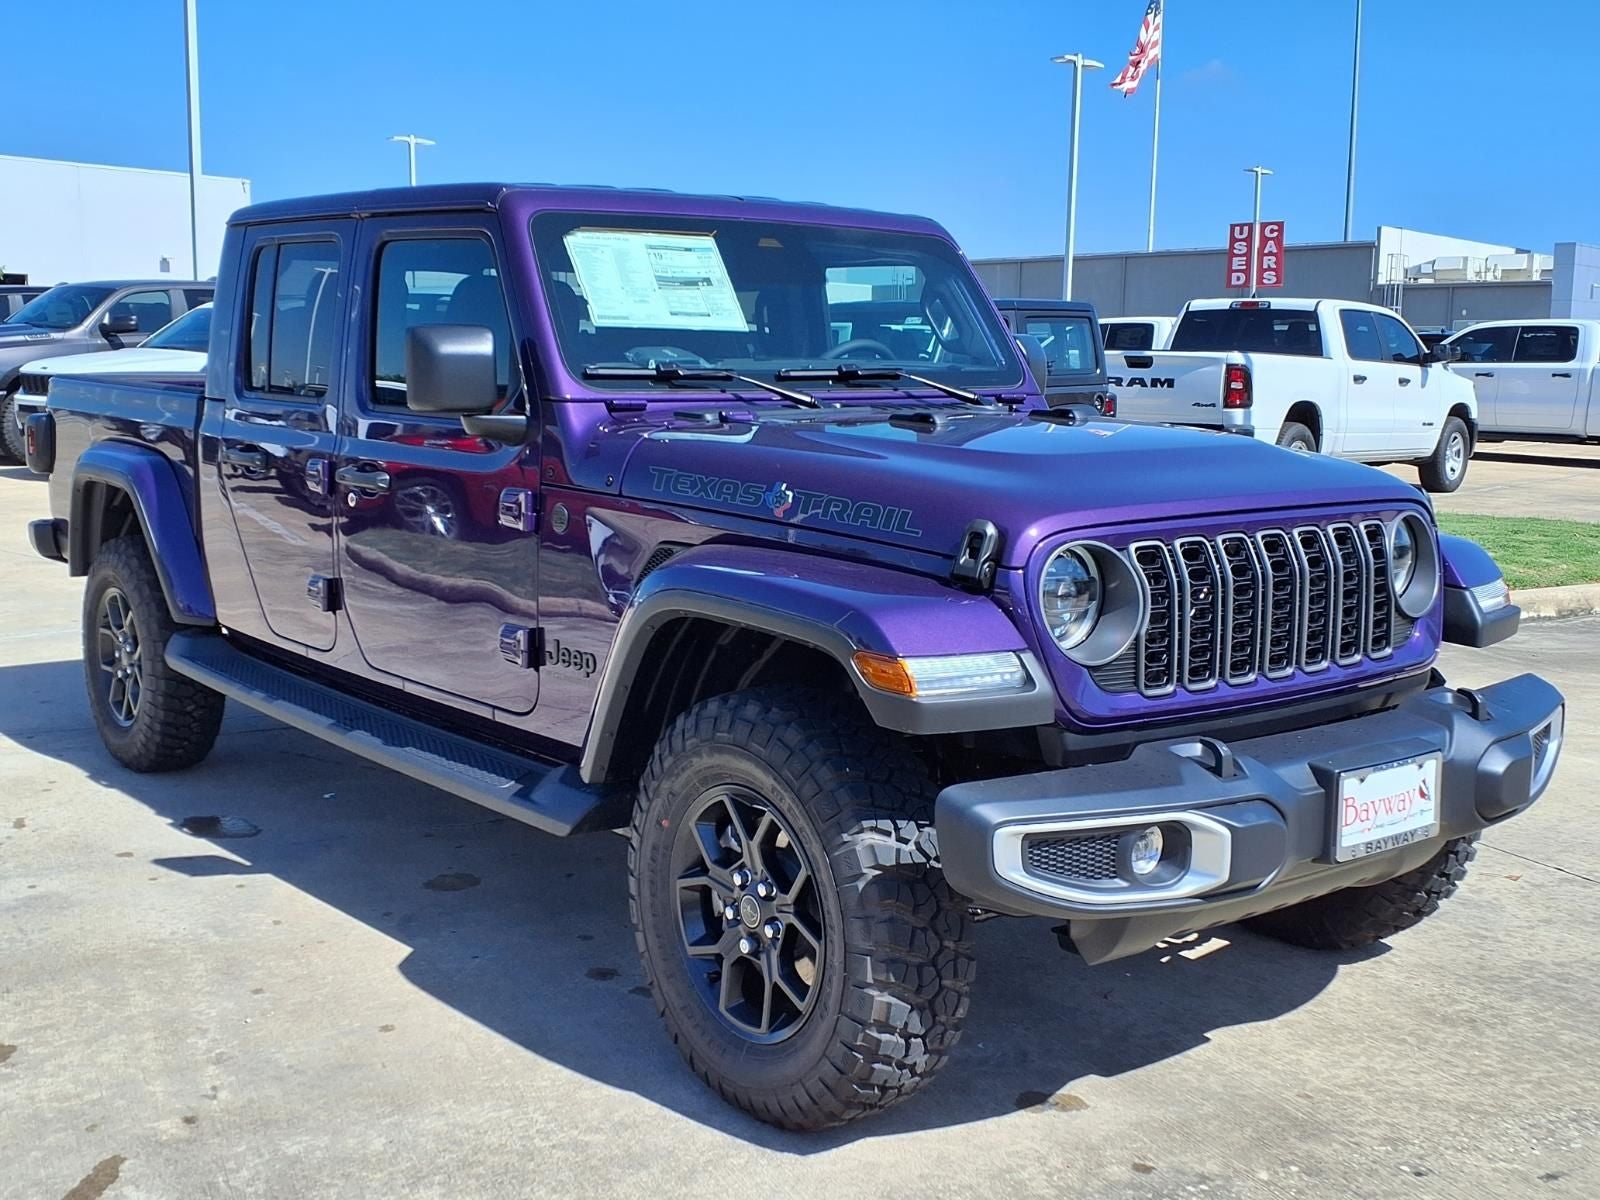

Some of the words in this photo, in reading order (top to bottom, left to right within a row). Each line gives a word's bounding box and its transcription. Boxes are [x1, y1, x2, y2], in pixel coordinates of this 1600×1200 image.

[1231, 225, 1249, 286] USED
[1262, 224, 1279, 284] CARS
[1107, 376, 1175, 389] RAM
[649, 466, 767, 507] TEXAS
[794, 489, 922, 537] TRAIL
[545, 638, 597, 678] Jeep
[1343, 788, 1417, 832] Bayway
[1365, 828, 1417, 854] BAYWAY
